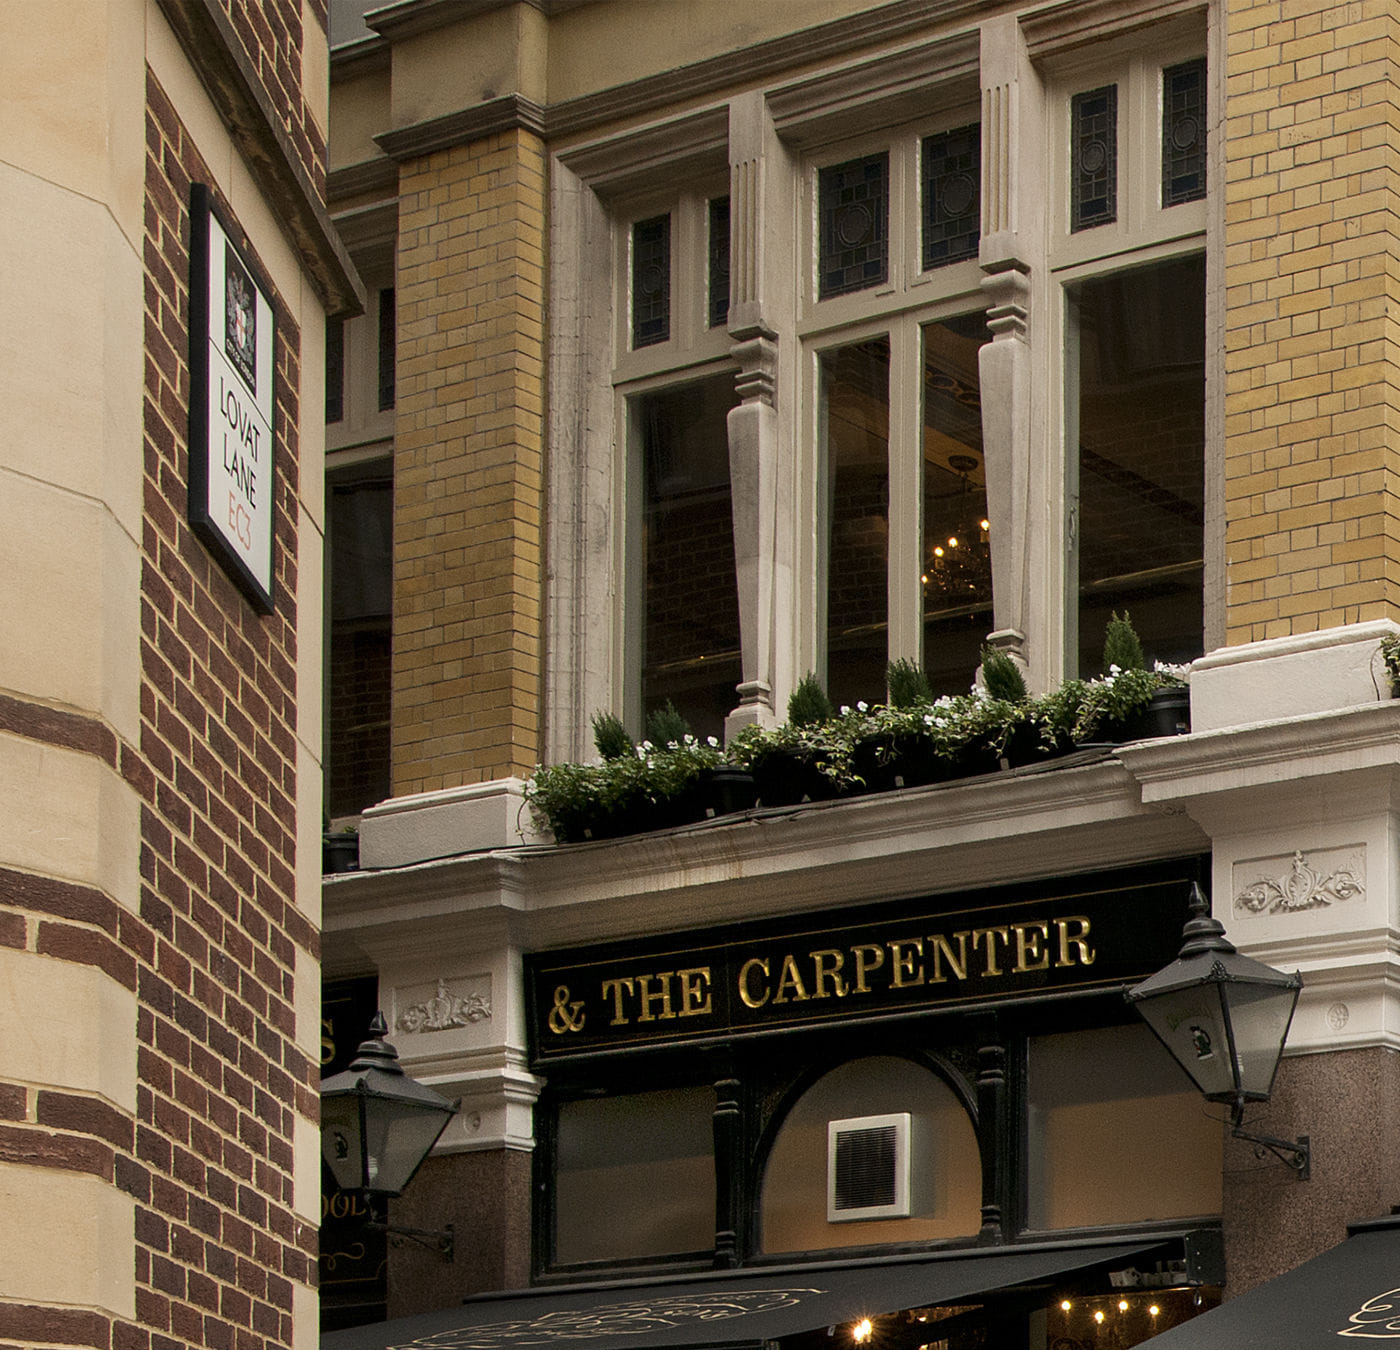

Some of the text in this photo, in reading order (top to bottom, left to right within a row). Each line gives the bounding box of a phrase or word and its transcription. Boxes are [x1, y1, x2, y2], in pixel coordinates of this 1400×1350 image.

[221, 376, 261, 463] LOVAT
[224, 432, 257, 510] LANE
[229, 489, 251, 552] EC3
[548, 915, 1097, 1034] & THE CARPENTER
